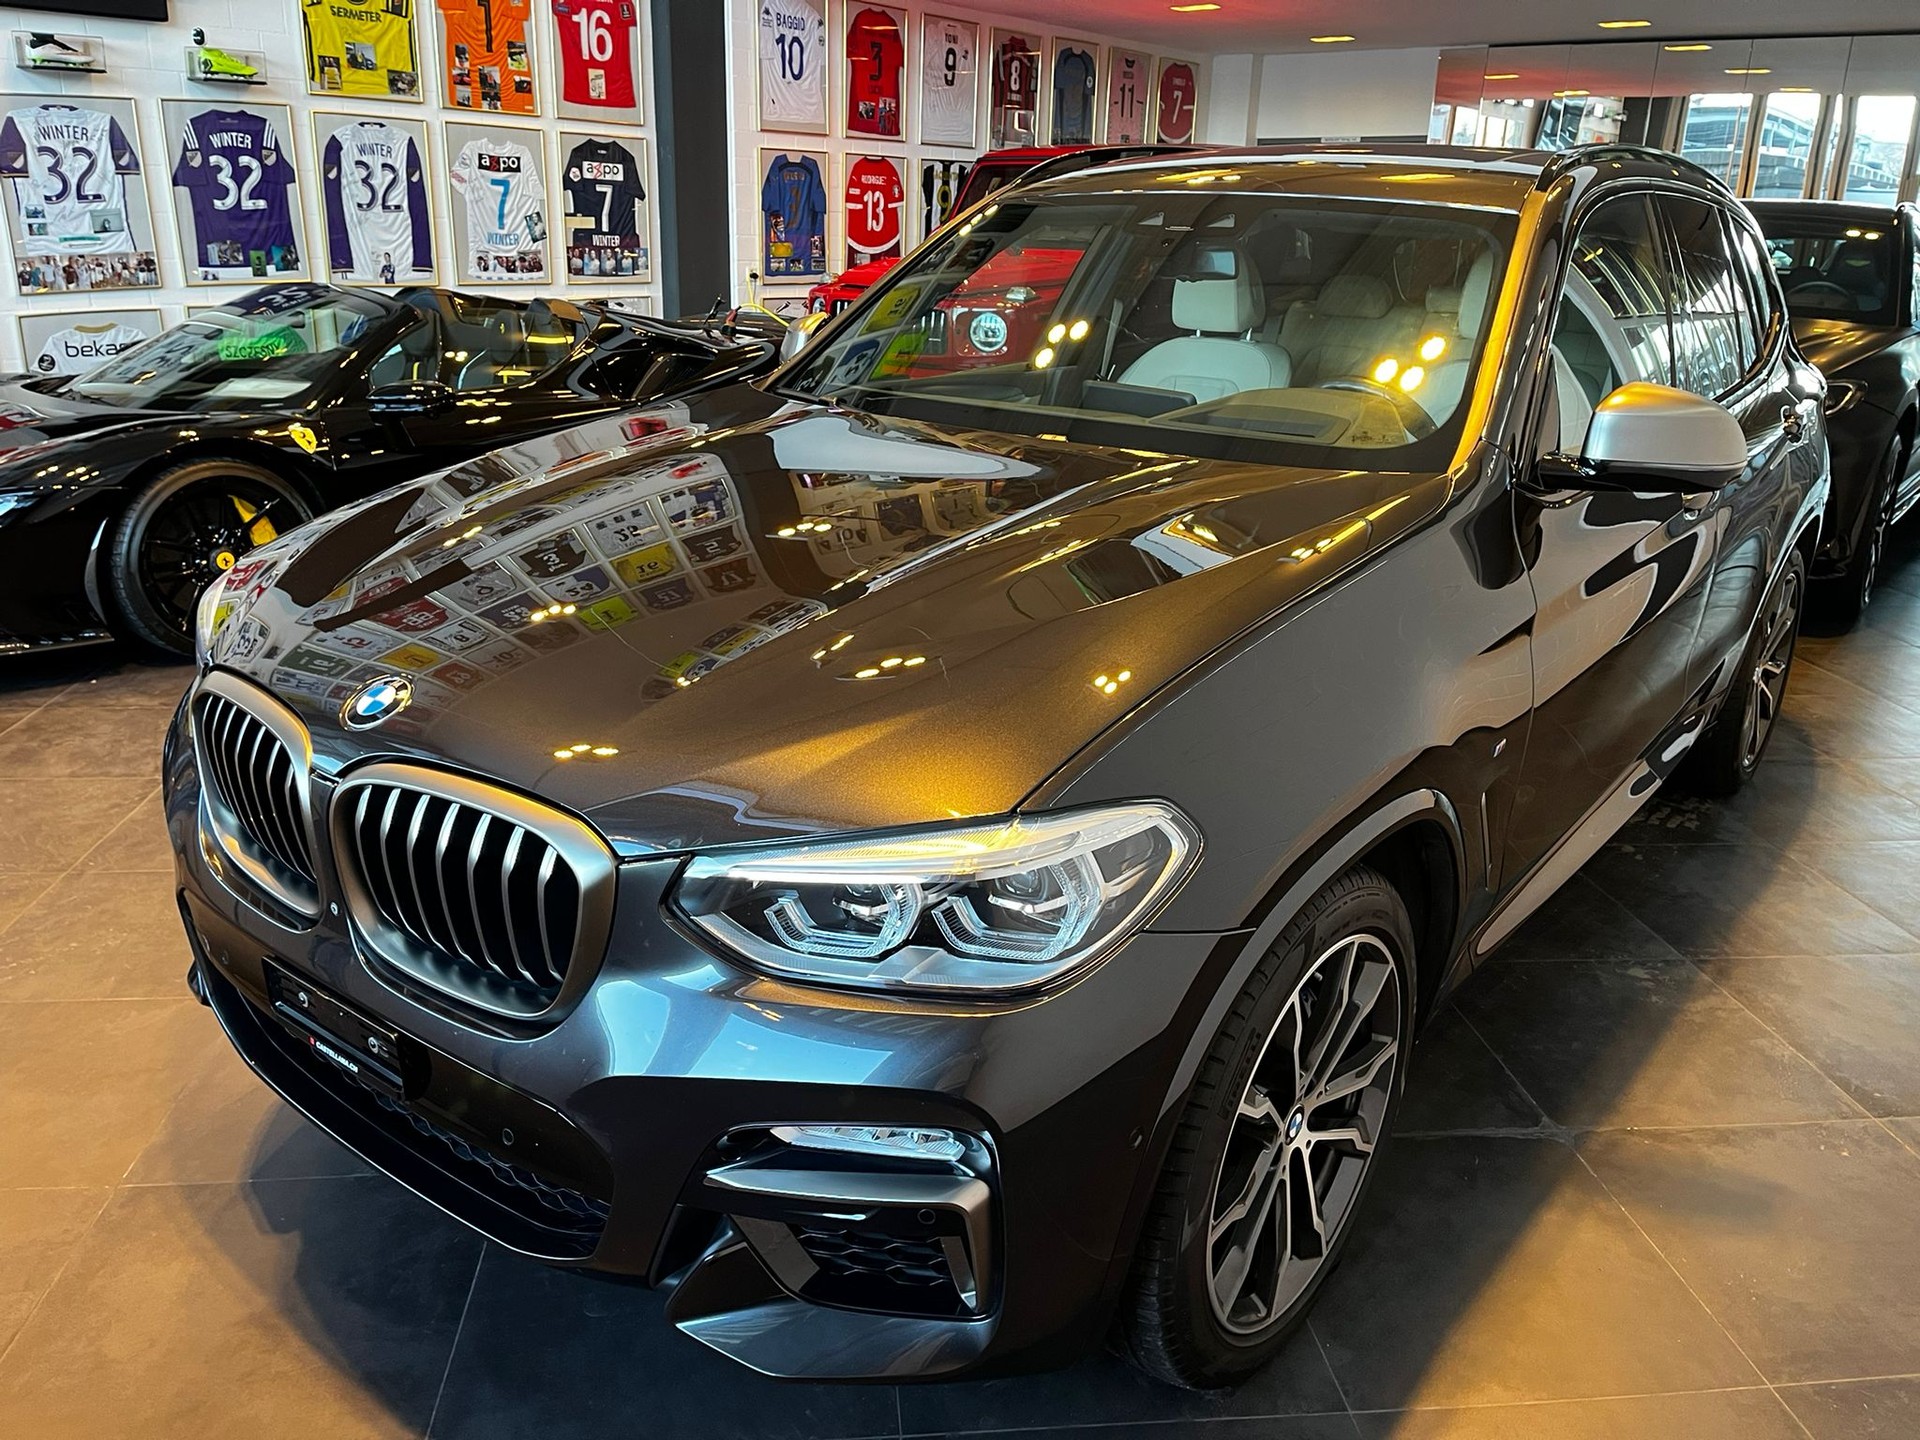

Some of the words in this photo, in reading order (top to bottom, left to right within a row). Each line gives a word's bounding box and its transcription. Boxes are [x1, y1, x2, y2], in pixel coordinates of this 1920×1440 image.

[571, 7, 613, 62] 16
[776, 12, 805, 31] BAGGIO
[775, 33, 804, 80] 10
[944, 47, 957, 87] 9
[1011, 60, 1020, 91] 8
[1120, 83, 1135, 118] 11
[1173, 90, 1183, 124] 7
[38, 125, 89, 142] WINTER
[209, 132, 252, 149] WINTER
[356, 142, 393, 159] WINTER
[37, 146, 106, 204] 32
[208, 154, 268, 210] 32
[354, 160, 404, 213] 32
[490, 179, 510, 230] 7
[595, 184, 613, 232] 7
[863, 190, 885, 232] 13
[487, 232, 520, 246] WINTER
[592, 234, 621, 247] WINTER
